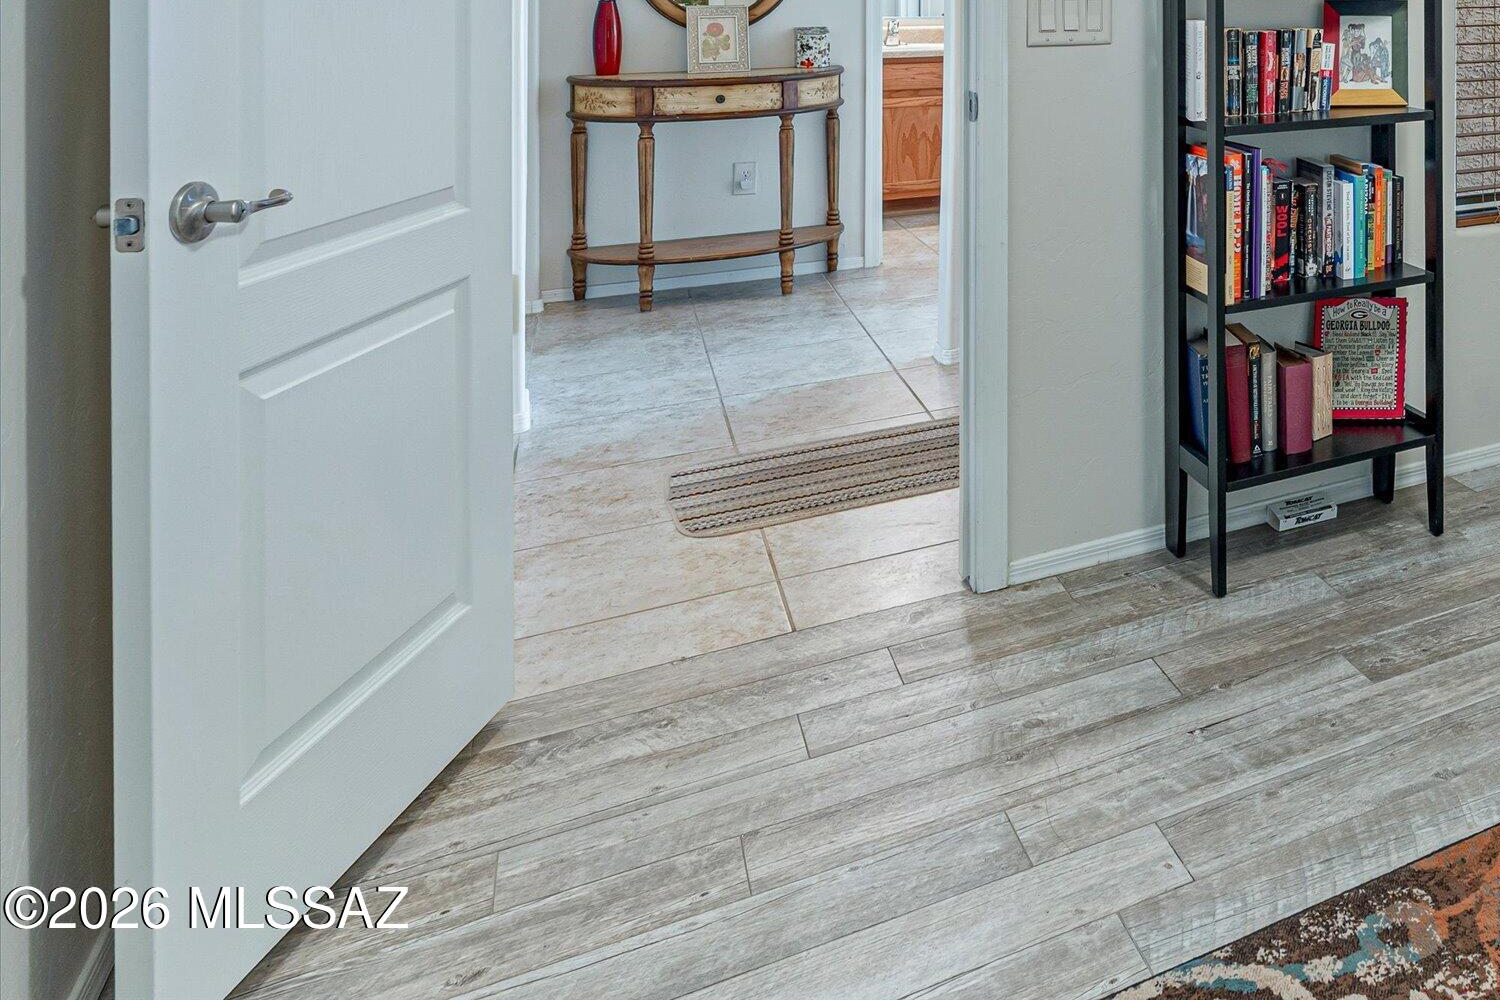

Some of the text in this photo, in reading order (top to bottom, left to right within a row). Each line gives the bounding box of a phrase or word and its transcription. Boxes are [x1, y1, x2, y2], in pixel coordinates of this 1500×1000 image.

[1353, 299, 1375, 312] Really
[1351, 311, 1368, 319] G
[1326, 320, 1358, 330] GEORGIA
[1285, 496, 1313, 506] TOMCAT
[1294, 512, 1324, 525] TOMCAT
